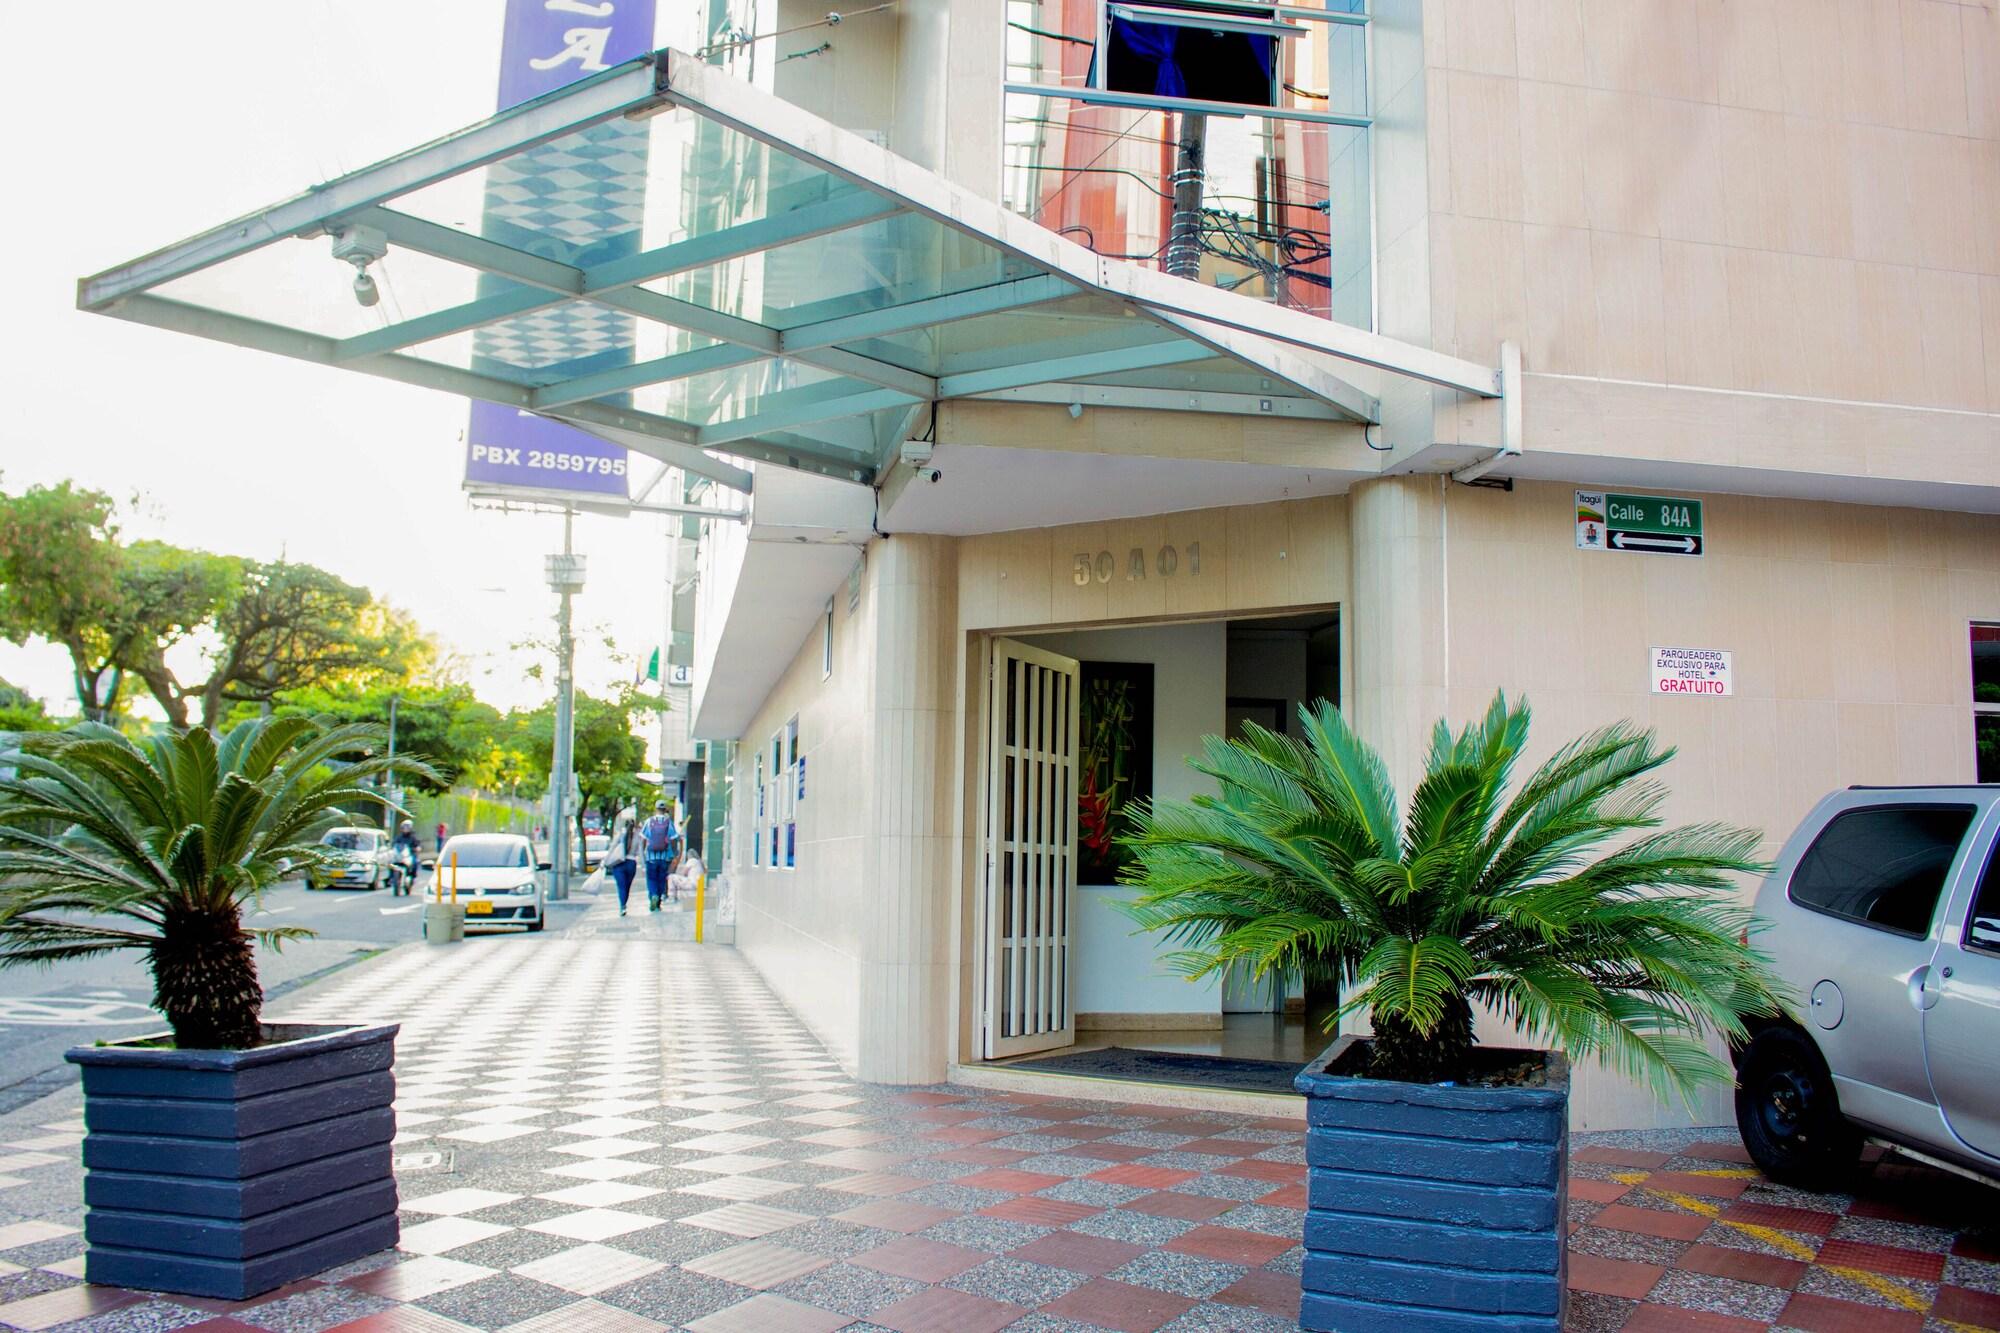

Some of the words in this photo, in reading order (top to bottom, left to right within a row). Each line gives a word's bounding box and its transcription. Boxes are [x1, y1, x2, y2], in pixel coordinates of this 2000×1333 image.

[472, 444, 521, 466] PBX
[527, 450, 626, 476] 2859795
[1609, 503, 1644, 521] Calle
[1661, 505, 1691, 528] 84A
[1072, 550, 1115, 586] 50
[1660, 649, 1722, 661] PARQUEADERO
[1657, 659, 1703, 670] EXCLUSIVO
[1704, 661, 1726, 670] PARA
[1678, 670, 1705, 680] HOTEL
[1660, 679, 1724, 694] GRATUITO
